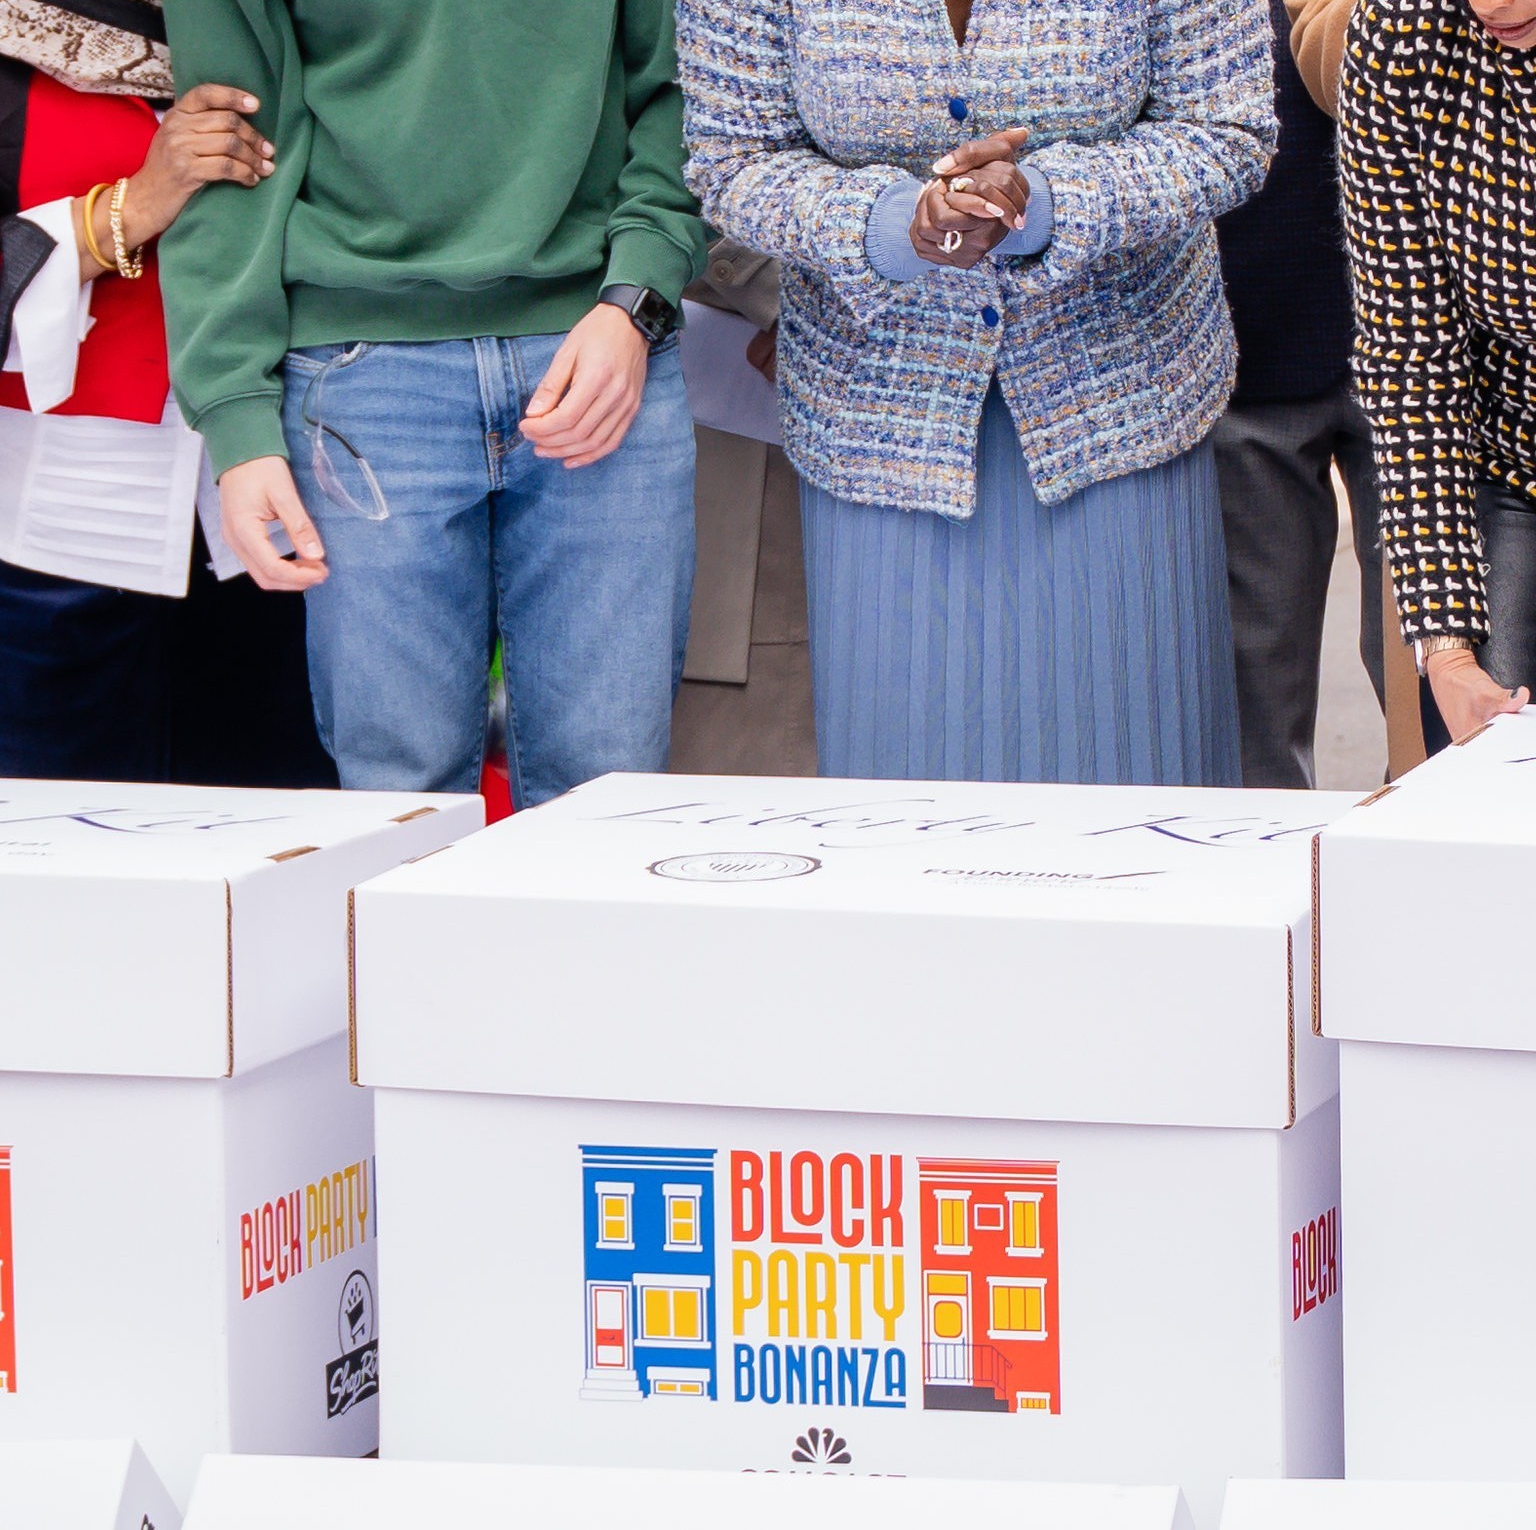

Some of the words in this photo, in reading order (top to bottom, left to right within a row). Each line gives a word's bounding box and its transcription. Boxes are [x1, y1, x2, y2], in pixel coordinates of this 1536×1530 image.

[584, 799, 1035, 848] Liberty
[1079, 814, 1327, 848] Kit
[923, 868, 1094, 880] FOUNDING
[240, 1189, 302, 1301] BLOCK
[305, 1159, 368, 1269] PARTY
[730, 1149, 904, 1248] BLOCK
[732, 1249, 906, 1341] PARTY
[1292, 1206, 1338, 1322] BLOCK
[733, 1343, 907, 1409] BONANZA
